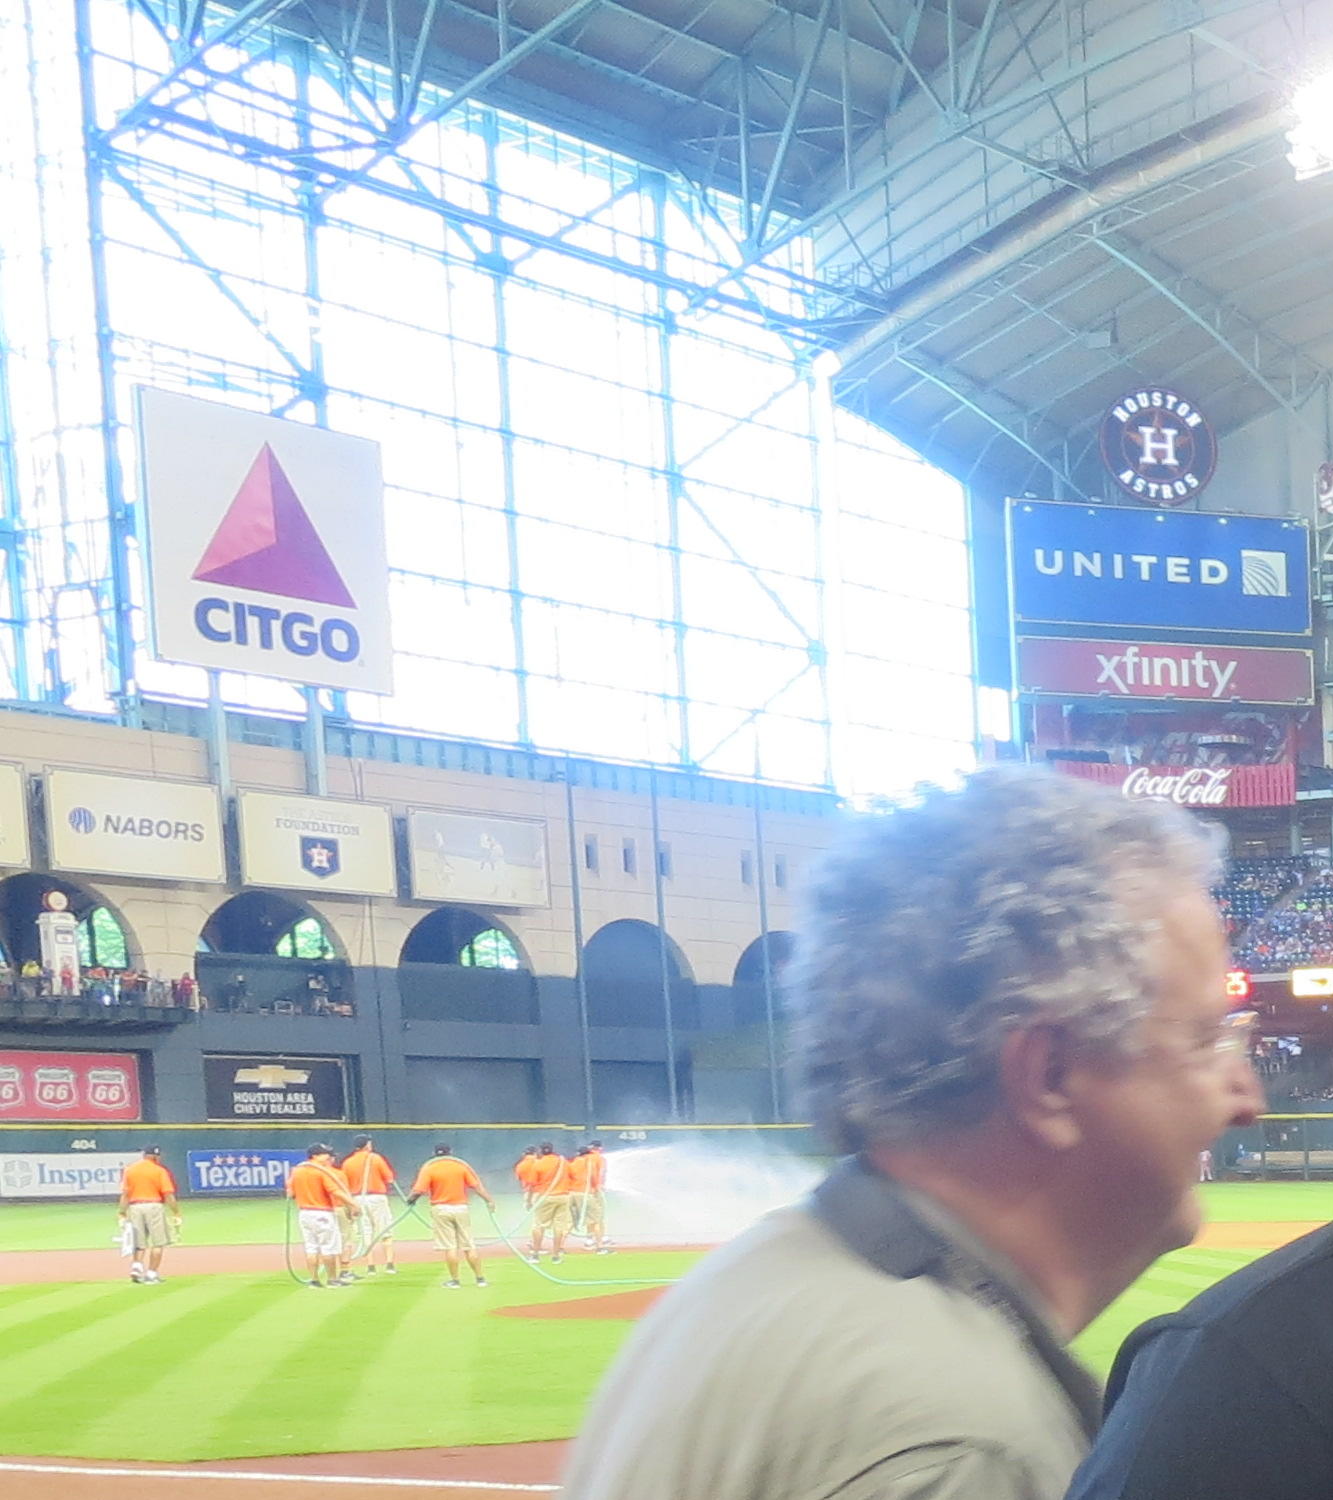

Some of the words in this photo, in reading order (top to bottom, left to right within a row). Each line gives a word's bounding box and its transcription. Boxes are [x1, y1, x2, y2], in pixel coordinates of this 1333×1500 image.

[1112, 391, 1202, 427] HOUSTON
[1138, 426, 1179, 465] H
[1119, 470, 1199, 499] ASTROS
[1034, 549, 1229, 585] UNITED
[194, 597, 360, 663] CITGO
[1096, 646, 1237, 697] xfinity
[1122, 766, 1233, 804] Coca-Cola
[103, 814, 205, 842] NABORS
[274, 817, 361, 836] FOUNDATION
[42, 1084, 70, 1101] 66
[94, 1085, 121, 1102] 66
[233, 1092, 284, 1104] HOUSTON
[286, 1093, 315, 1105] AREA
[234, 1103, 267, 1115] CHEVY
[270, 1104, 315, 1115] DEALERS
